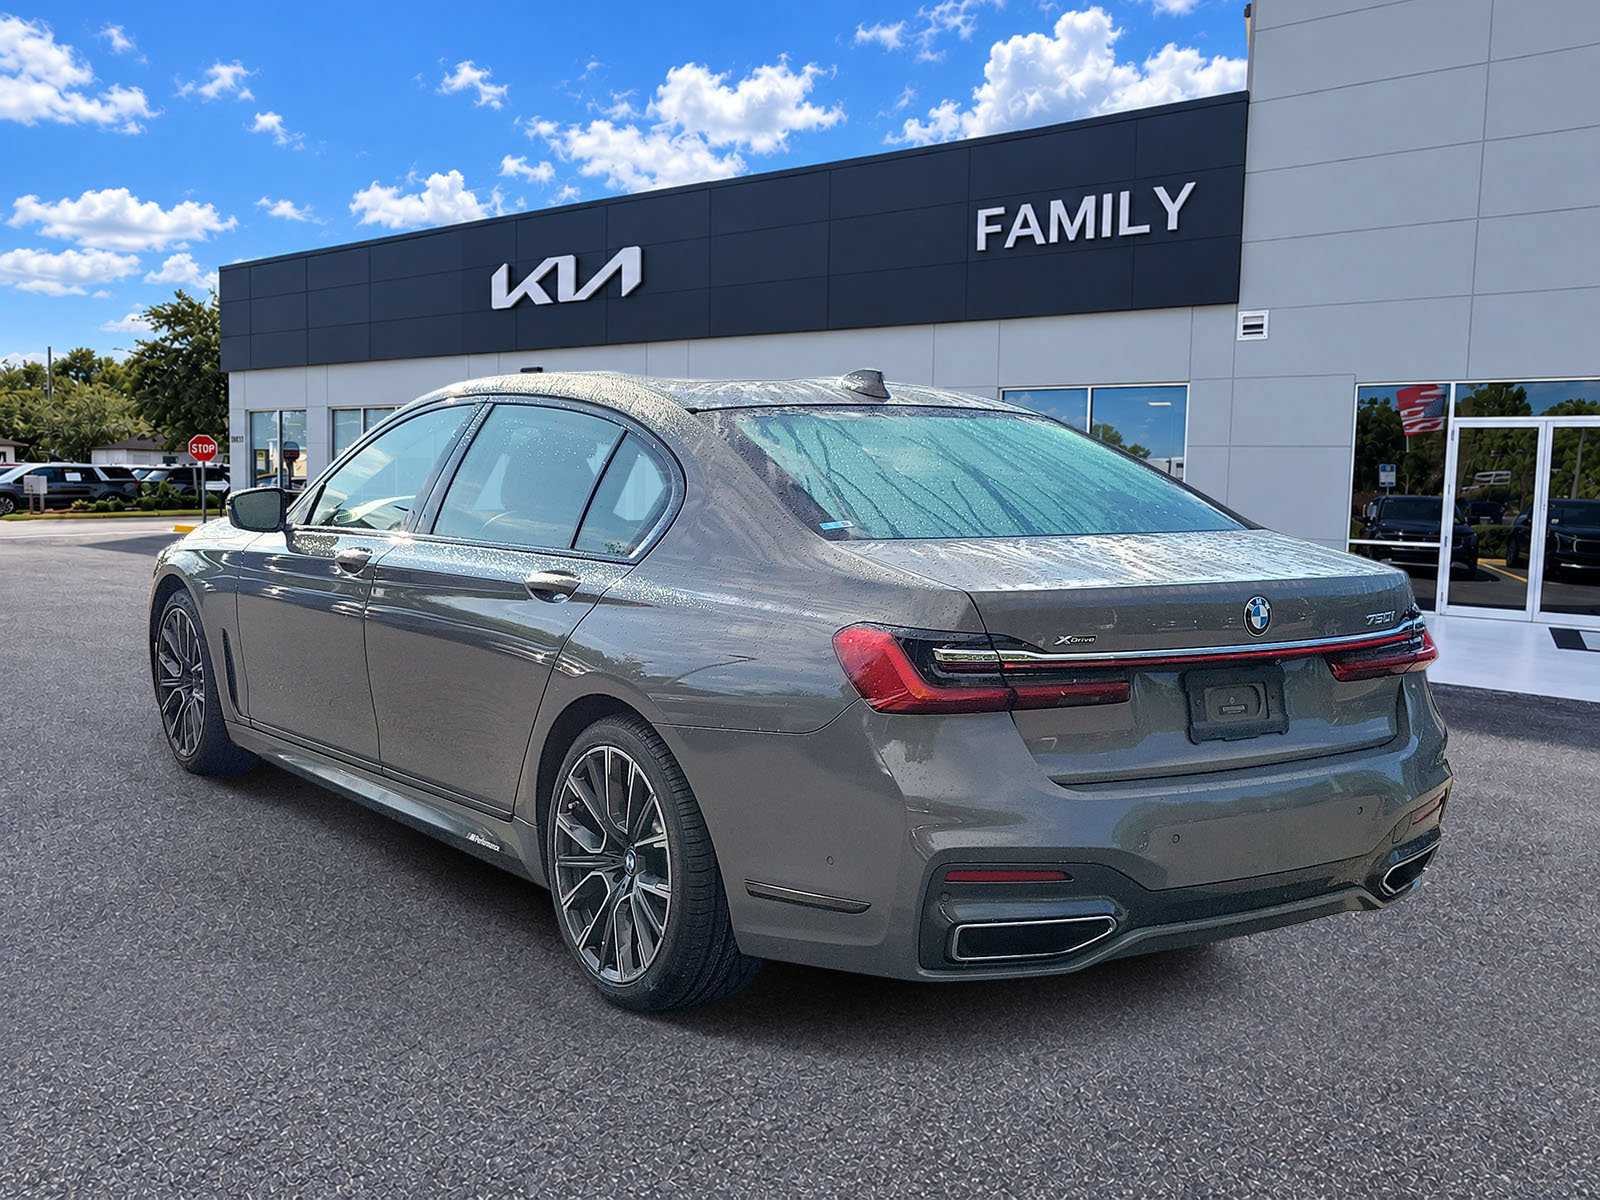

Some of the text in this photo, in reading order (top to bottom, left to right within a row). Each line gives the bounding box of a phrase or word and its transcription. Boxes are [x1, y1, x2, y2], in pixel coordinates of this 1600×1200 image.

[977, 182, 1196, 251] FAMILY
[491, 246, 642, 310] KIA
[191, 443, 215, 454] STOP
